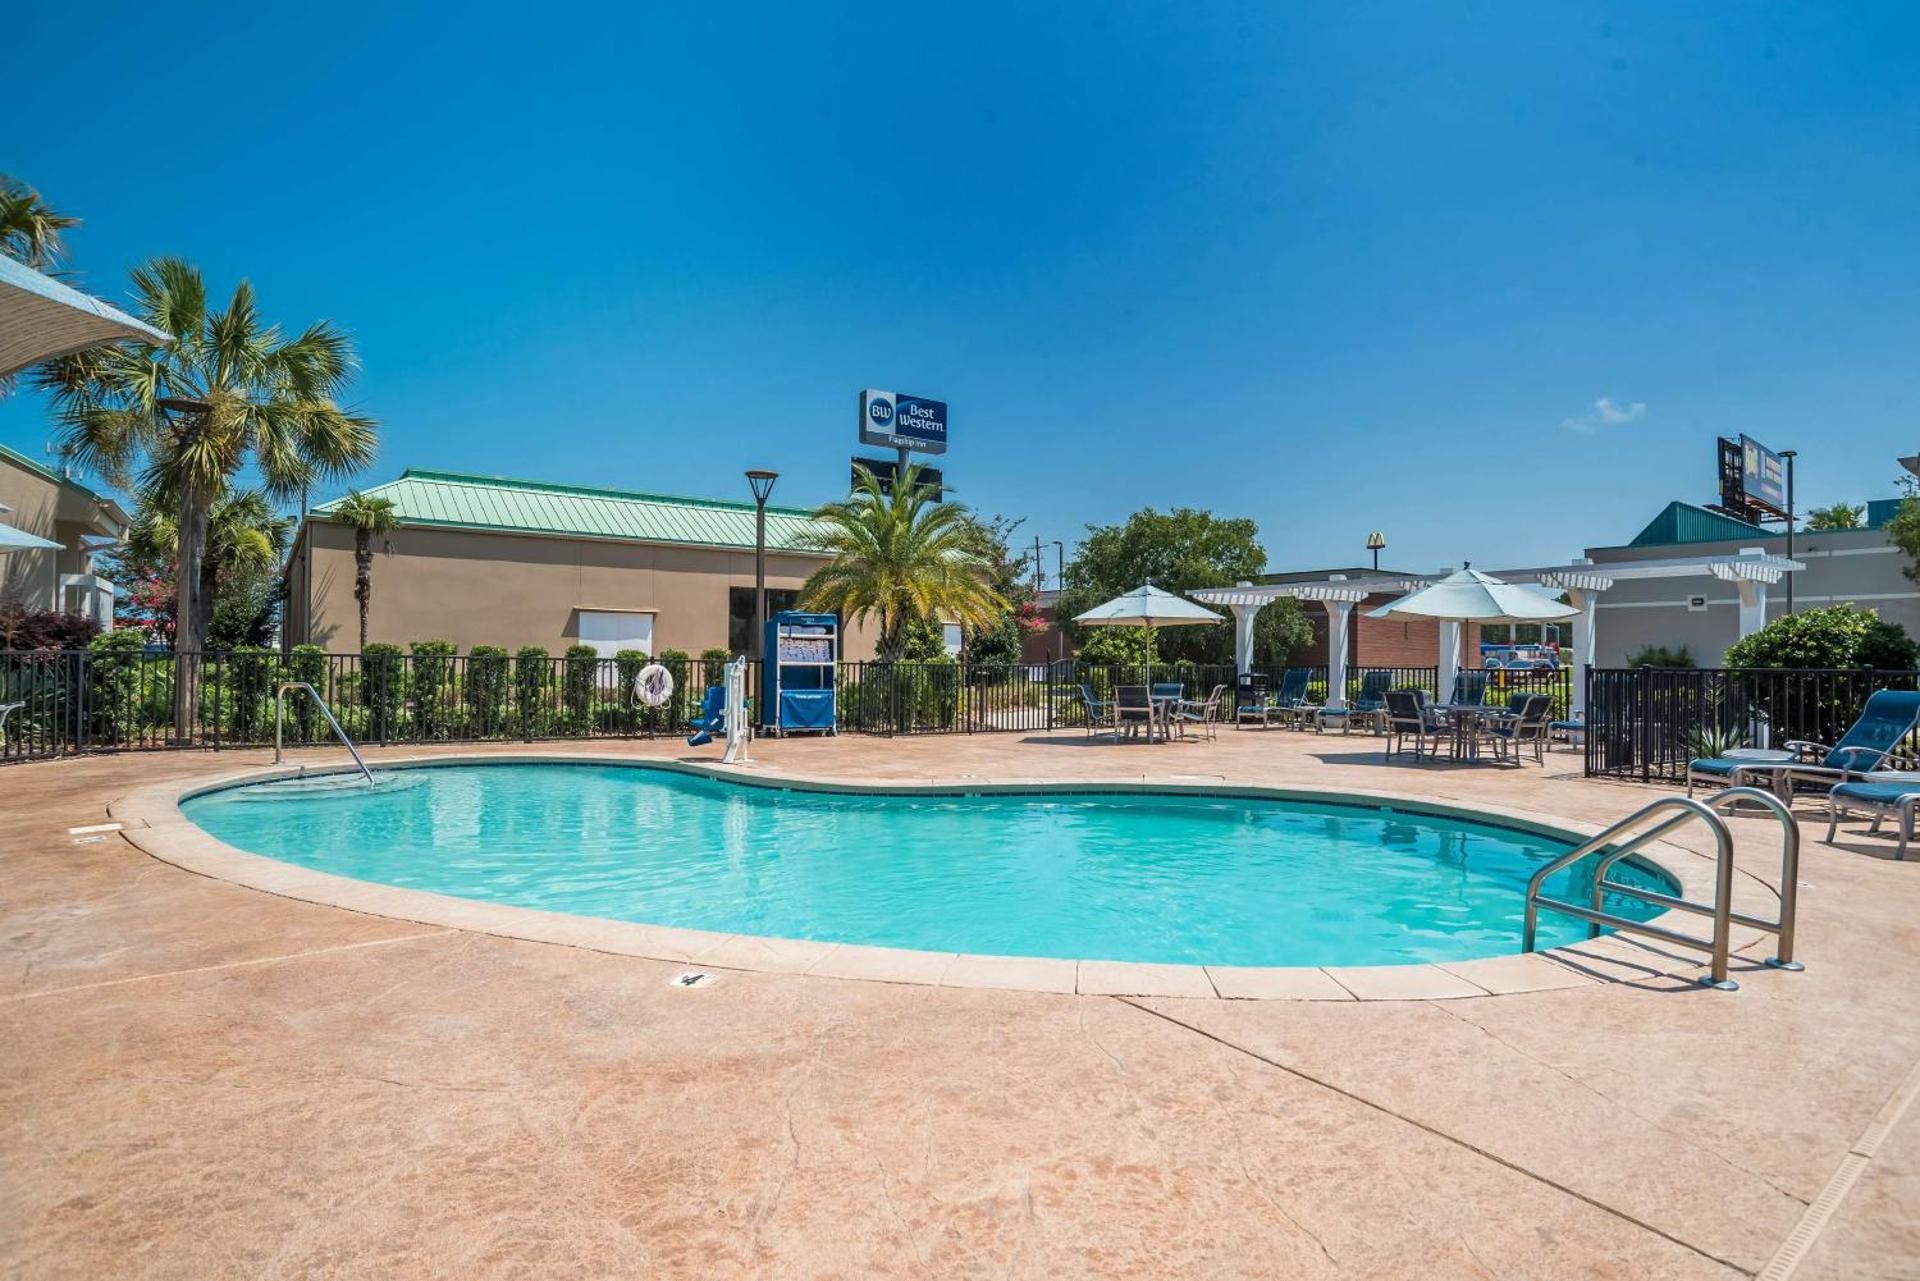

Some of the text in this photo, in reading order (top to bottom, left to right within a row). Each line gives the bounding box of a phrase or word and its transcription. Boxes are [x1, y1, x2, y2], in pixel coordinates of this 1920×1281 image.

[872, 404, 892, 419] BW
[910, 404, 934, 419] Best
[899, 413, 943, 432] Western
